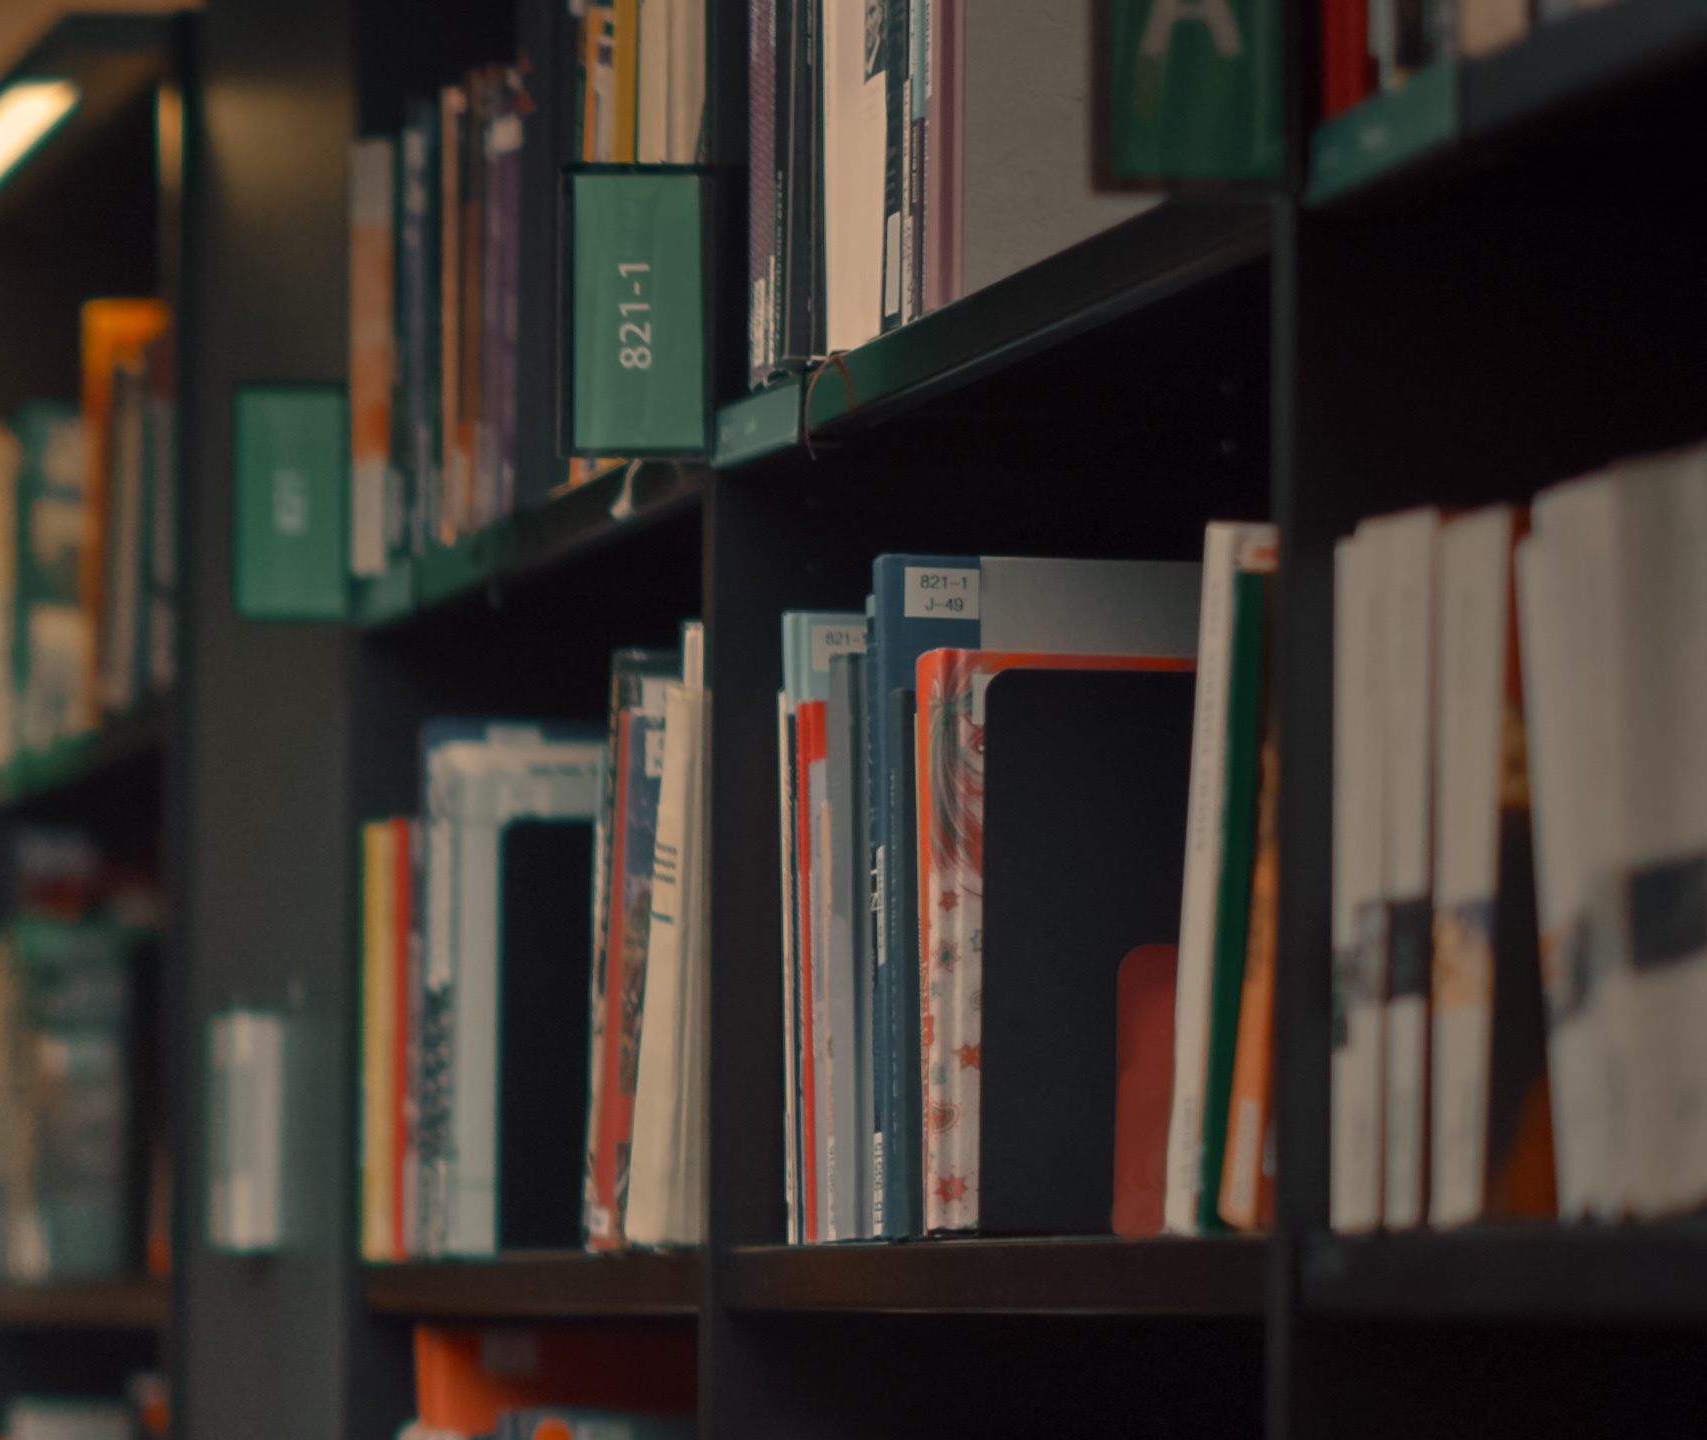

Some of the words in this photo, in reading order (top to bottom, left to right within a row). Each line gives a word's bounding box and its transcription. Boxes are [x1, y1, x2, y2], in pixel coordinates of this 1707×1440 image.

[618, 260, 652, 370] 821-1
[920, 575, 968, 591] 821-1
[925, 597, 965, 612] J-49
